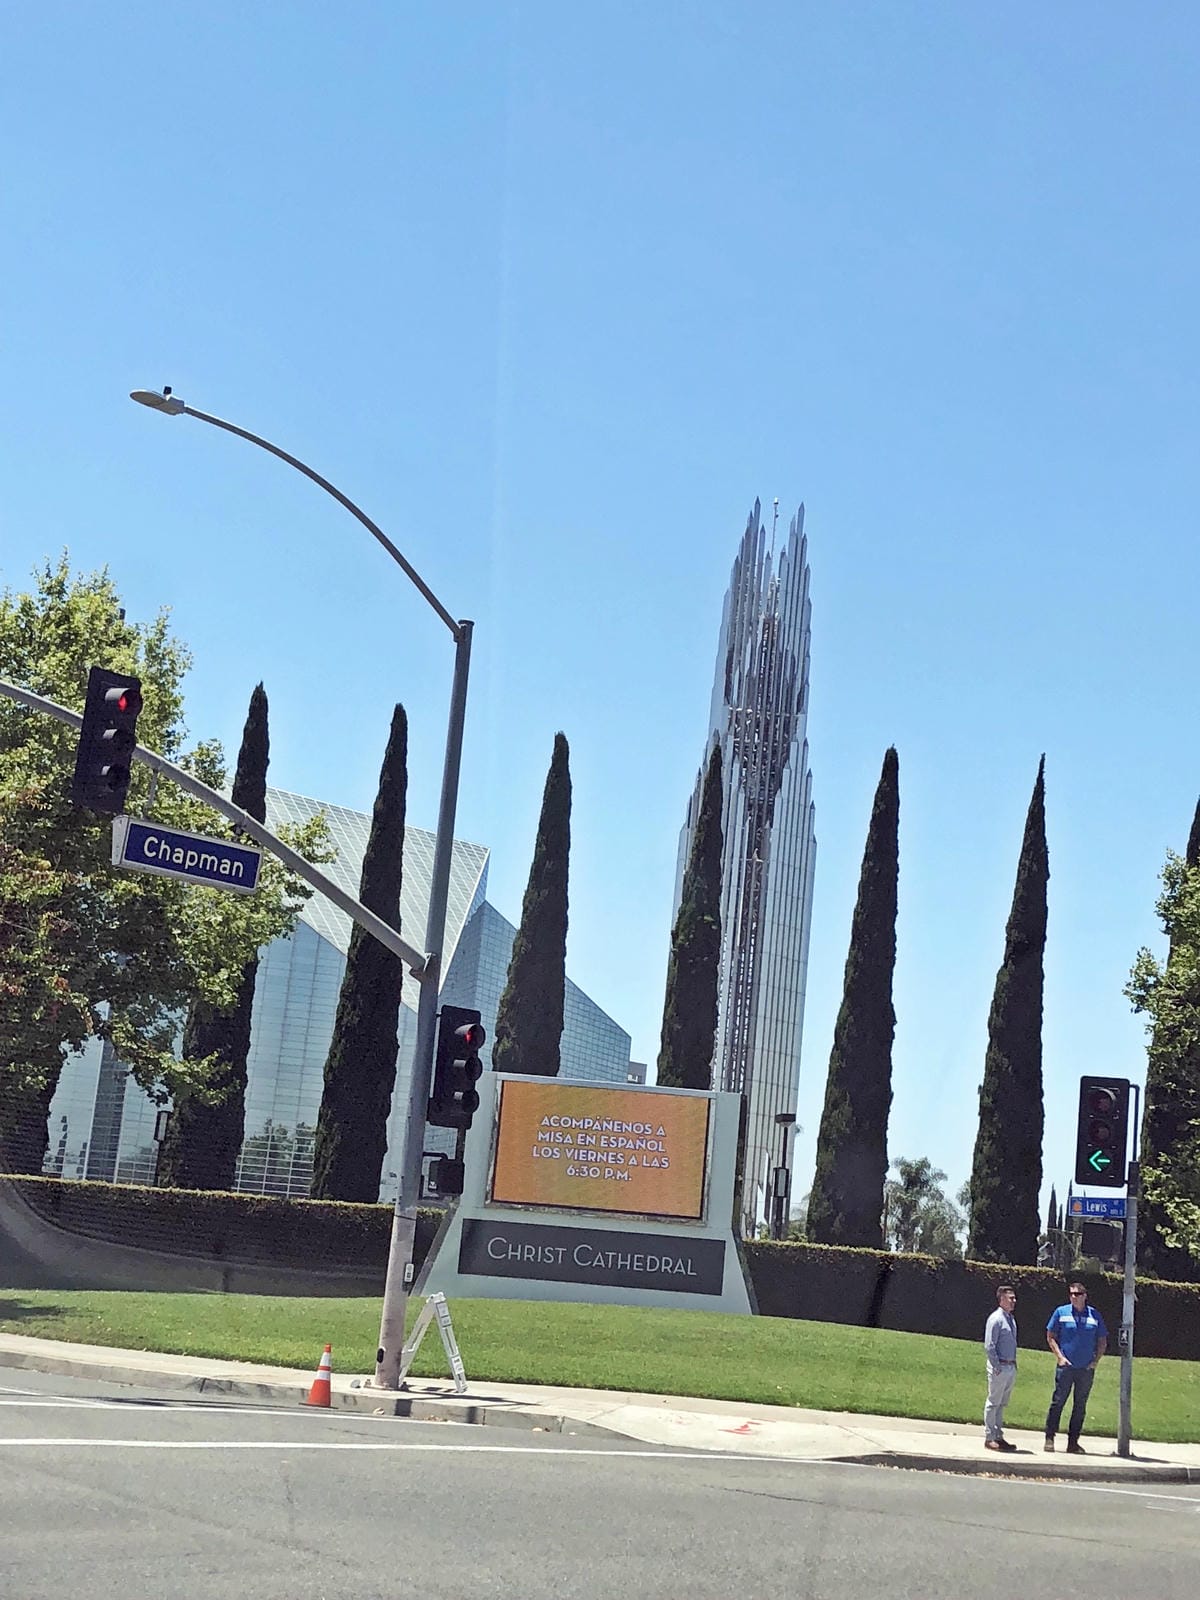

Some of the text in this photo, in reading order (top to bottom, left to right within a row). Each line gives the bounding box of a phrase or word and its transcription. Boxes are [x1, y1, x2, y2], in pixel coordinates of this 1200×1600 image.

[143, 836, 244, 878] Chapman
[541, 1115, 666, 1137] ACOMPÁÑENOS A
[538, 1131, 666, 1152] MISA EN ESPAÑOL
[532, 1146, 670, 1168] LOS VIERNES A LAS
[567, 1165, 632, 1181] 6:30 P.M.
[1086, 1200, 1108, 1213] Lewis
[487, 1237, 697, 1276] CHRIST CATHEDRAL
